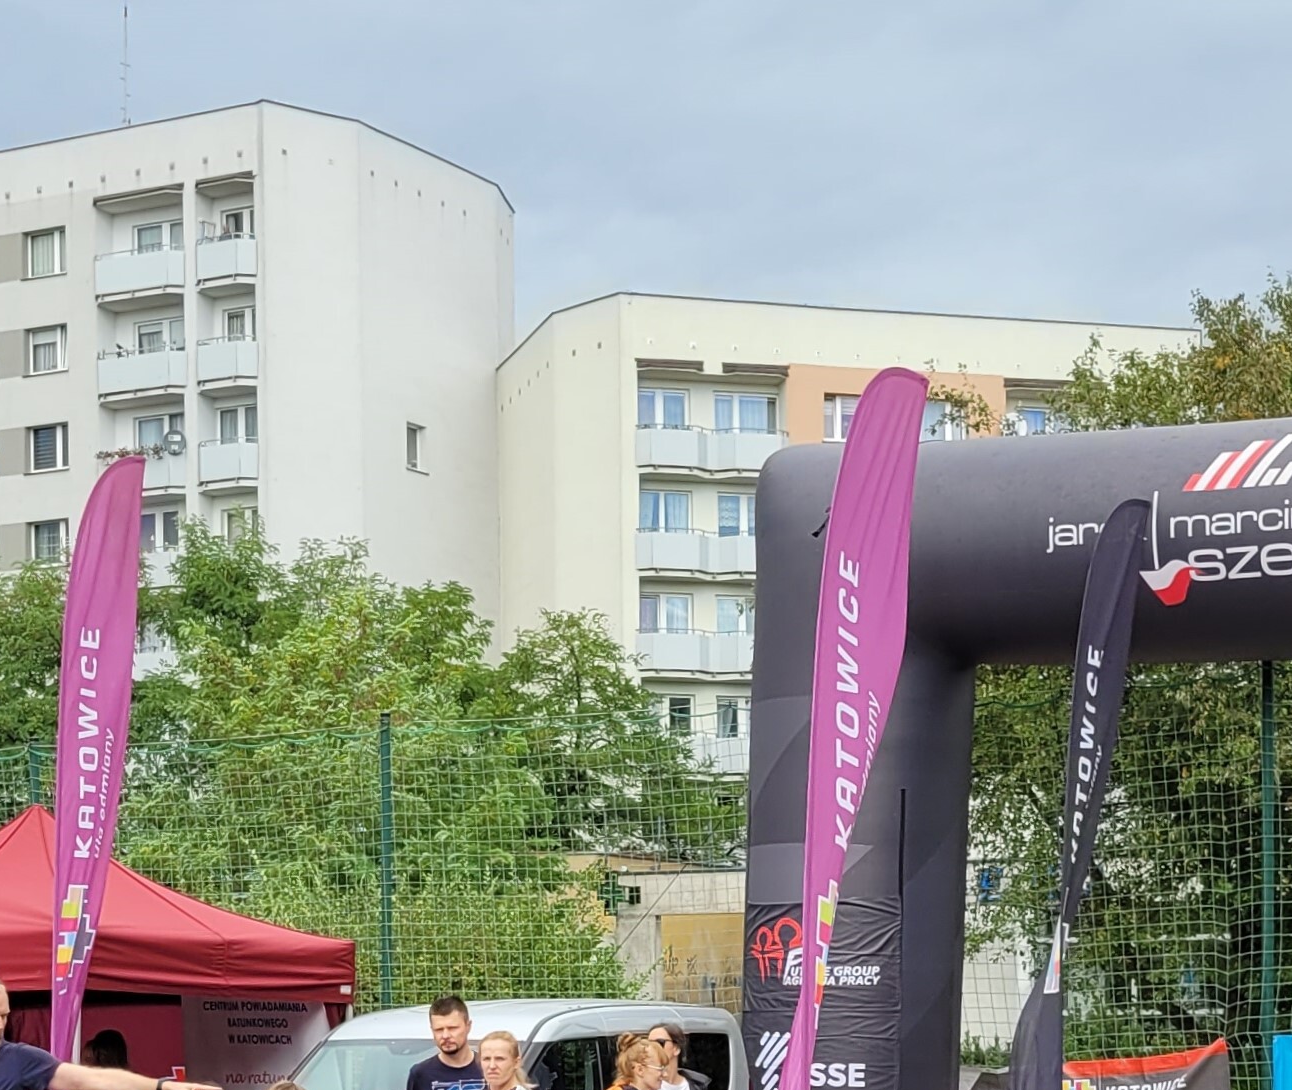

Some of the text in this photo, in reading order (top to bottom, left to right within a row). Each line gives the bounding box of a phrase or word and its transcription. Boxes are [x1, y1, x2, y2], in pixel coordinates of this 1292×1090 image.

[1047, 517, 1106, 553] jar
[833, 551, 861, 852] KATOWICE
[73, 626, 101, 860] KATOWICE
[99, 728, 115, 822] odmiany
[833, 966, 881, 976] GROUP
[839, 976, 881, 986] PRACY
[203, 1002, 308, 1012] CENTRUM POWIADAMIANIA
[228, 1018, 288, 1028] RATUNKOWEGO
[229, 1035, 292, 1045] W KATOWICACH
[225, 1074, 244, 1084] na
[810, 1063, 866, 1087] SSE
